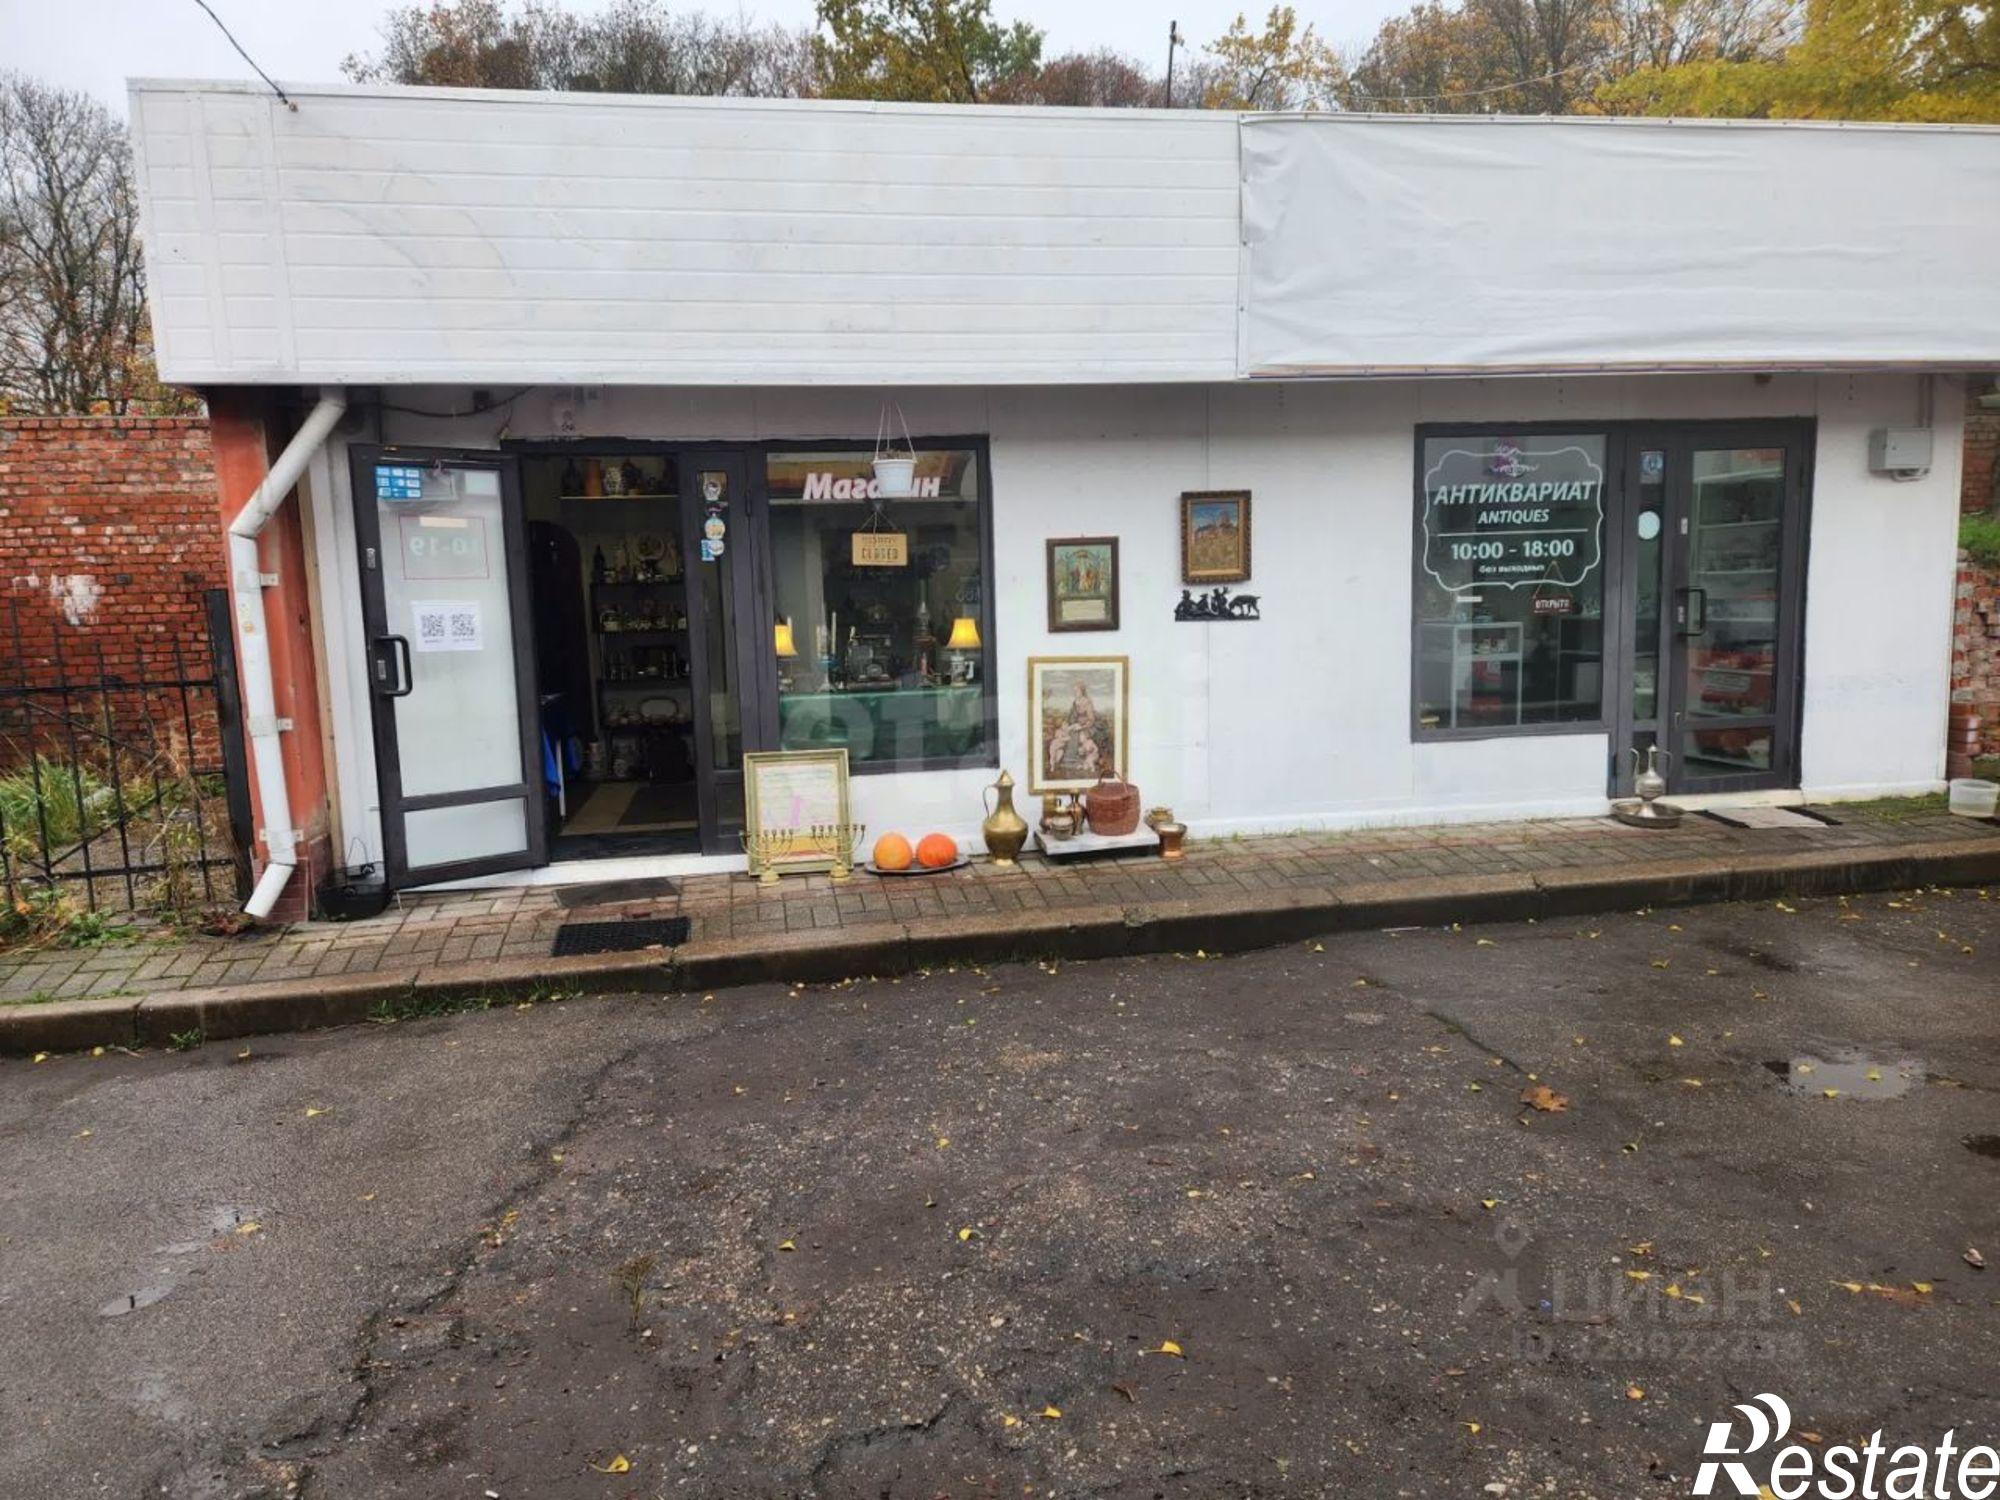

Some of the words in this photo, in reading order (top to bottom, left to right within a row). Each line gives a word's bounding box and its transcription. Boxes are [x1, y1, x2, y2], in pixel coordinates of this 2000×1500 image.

[803, 473, 941, 500] Магаин
[1434, 481, 1597, 505] АНТИКВАРИАТ
[1478, 509, 1550, 525] ANTIQUES
[1451, 541, 1504, 560] 10:00
[1522, 539, 1575, 557] 18:00
